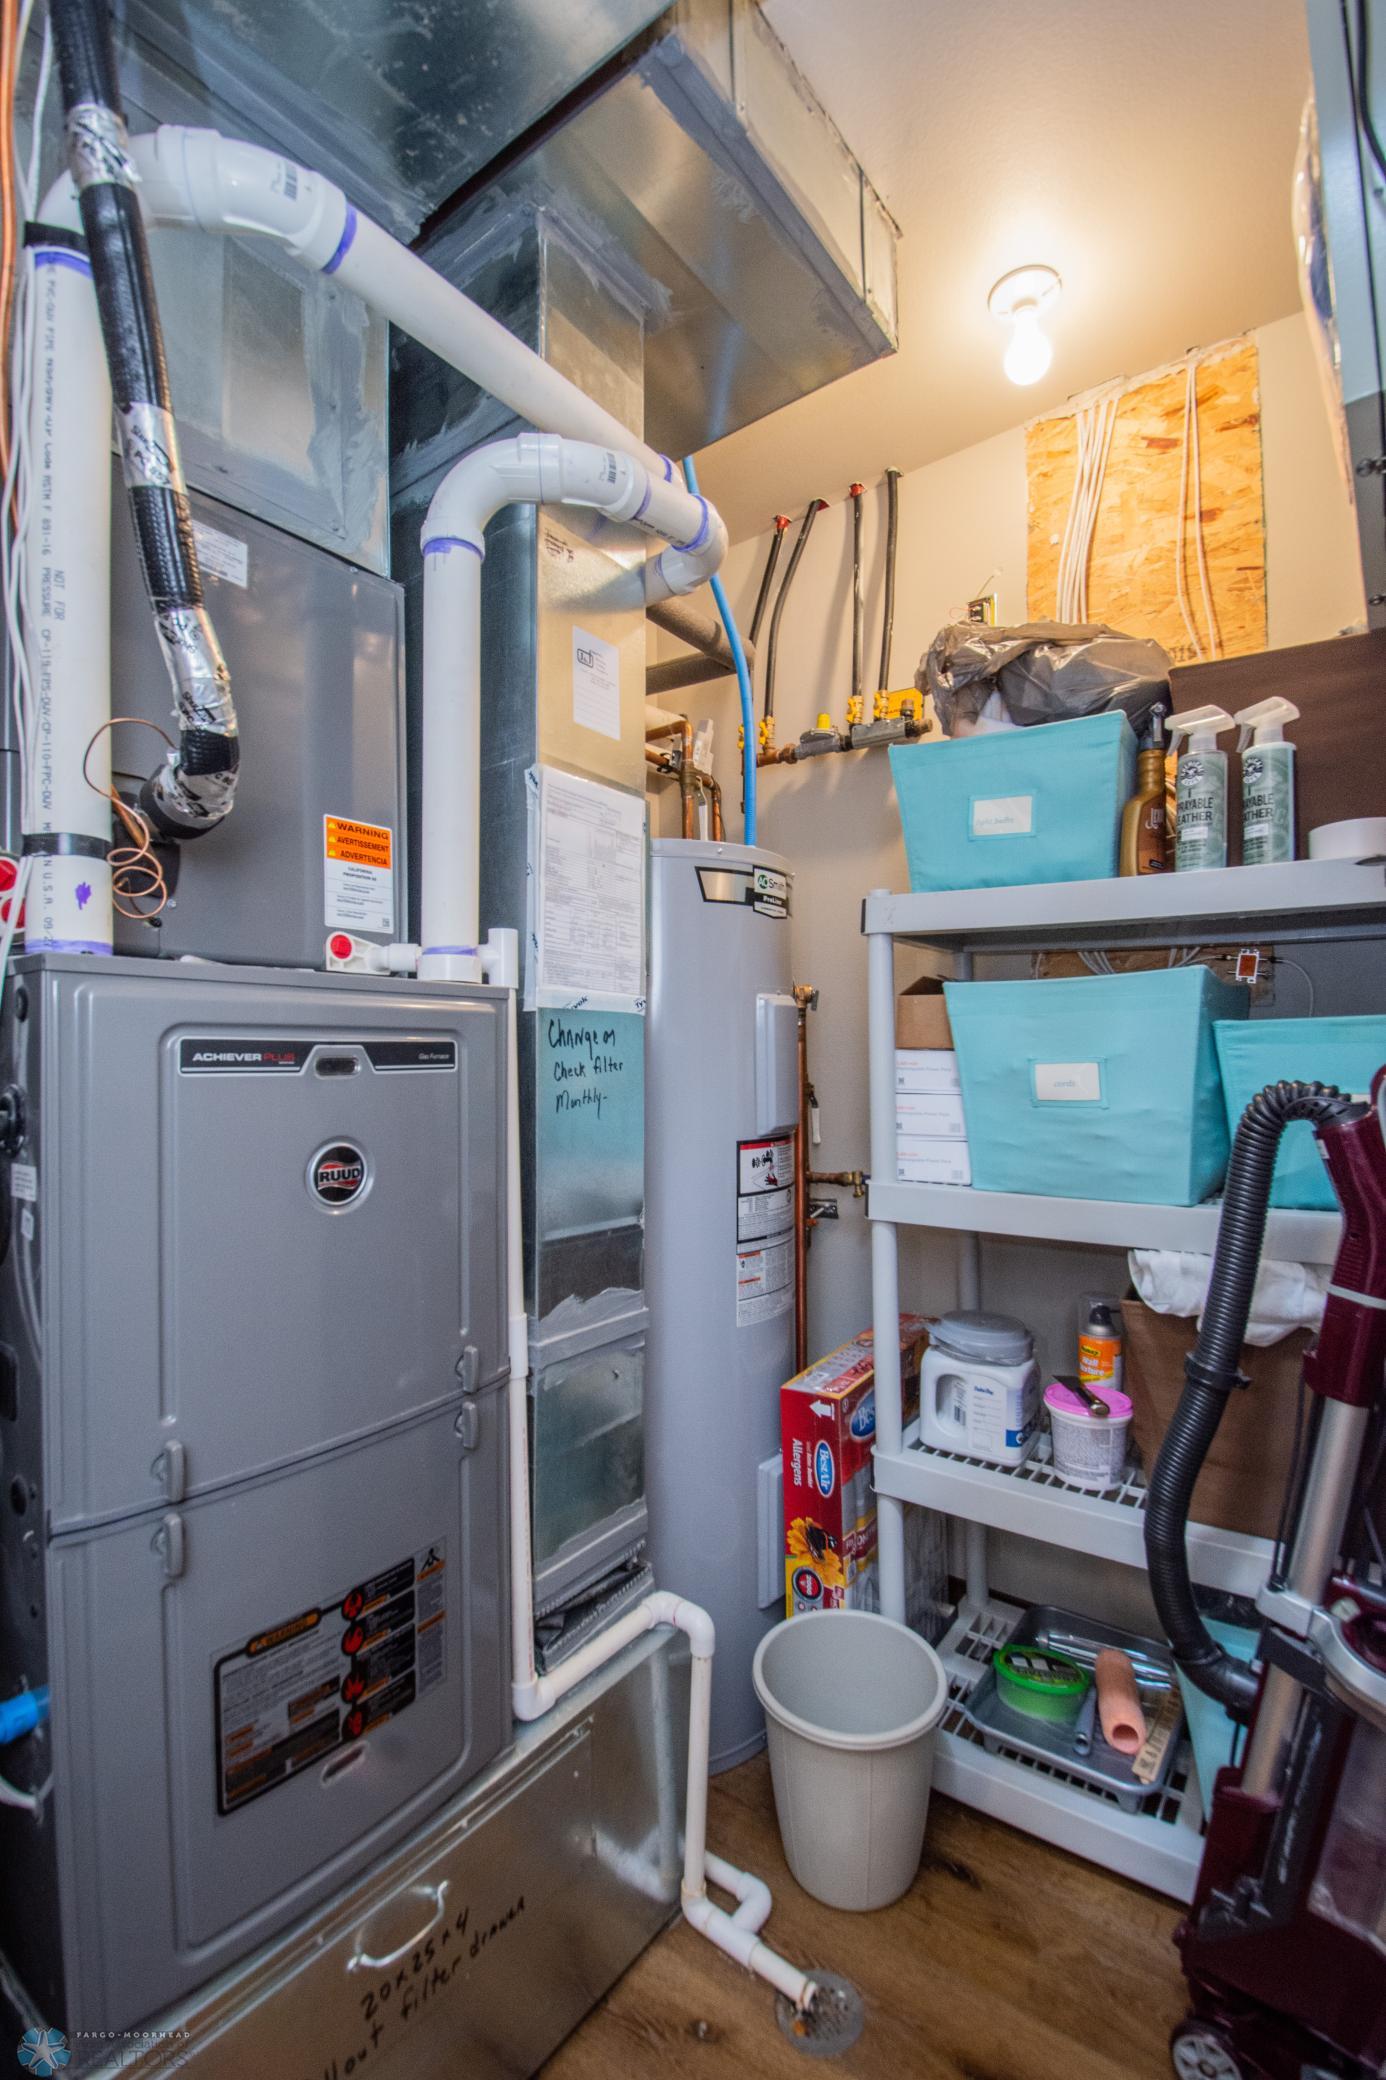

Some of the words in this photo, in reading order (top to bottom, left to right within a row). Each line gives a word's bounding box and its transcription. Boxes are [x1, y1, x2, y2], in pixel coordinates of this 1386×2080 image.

[42, 475, 52, 500] ASTM
[54, 570, 66, 590] NOT
[41, 567, 52, 617] PRESSURE
[54, 600, 66, 621] FOR
[336, 821, 389, 841] WARNING
[336, 836, 389, 853] AVERTISSEMENT
[340, 850, 388, 866] ADVERTENCIA
[192, 1052, 262, 1061] ACHIEVER
[263, 1052, 297, 1061] PLUS
[553, 1060, 585, 1081] Check
[319, 1168, 361, 1182] RUUD
[790, 1438, 803, 1487] Allergens
[819, 1449, 831, 1490] BestAir
